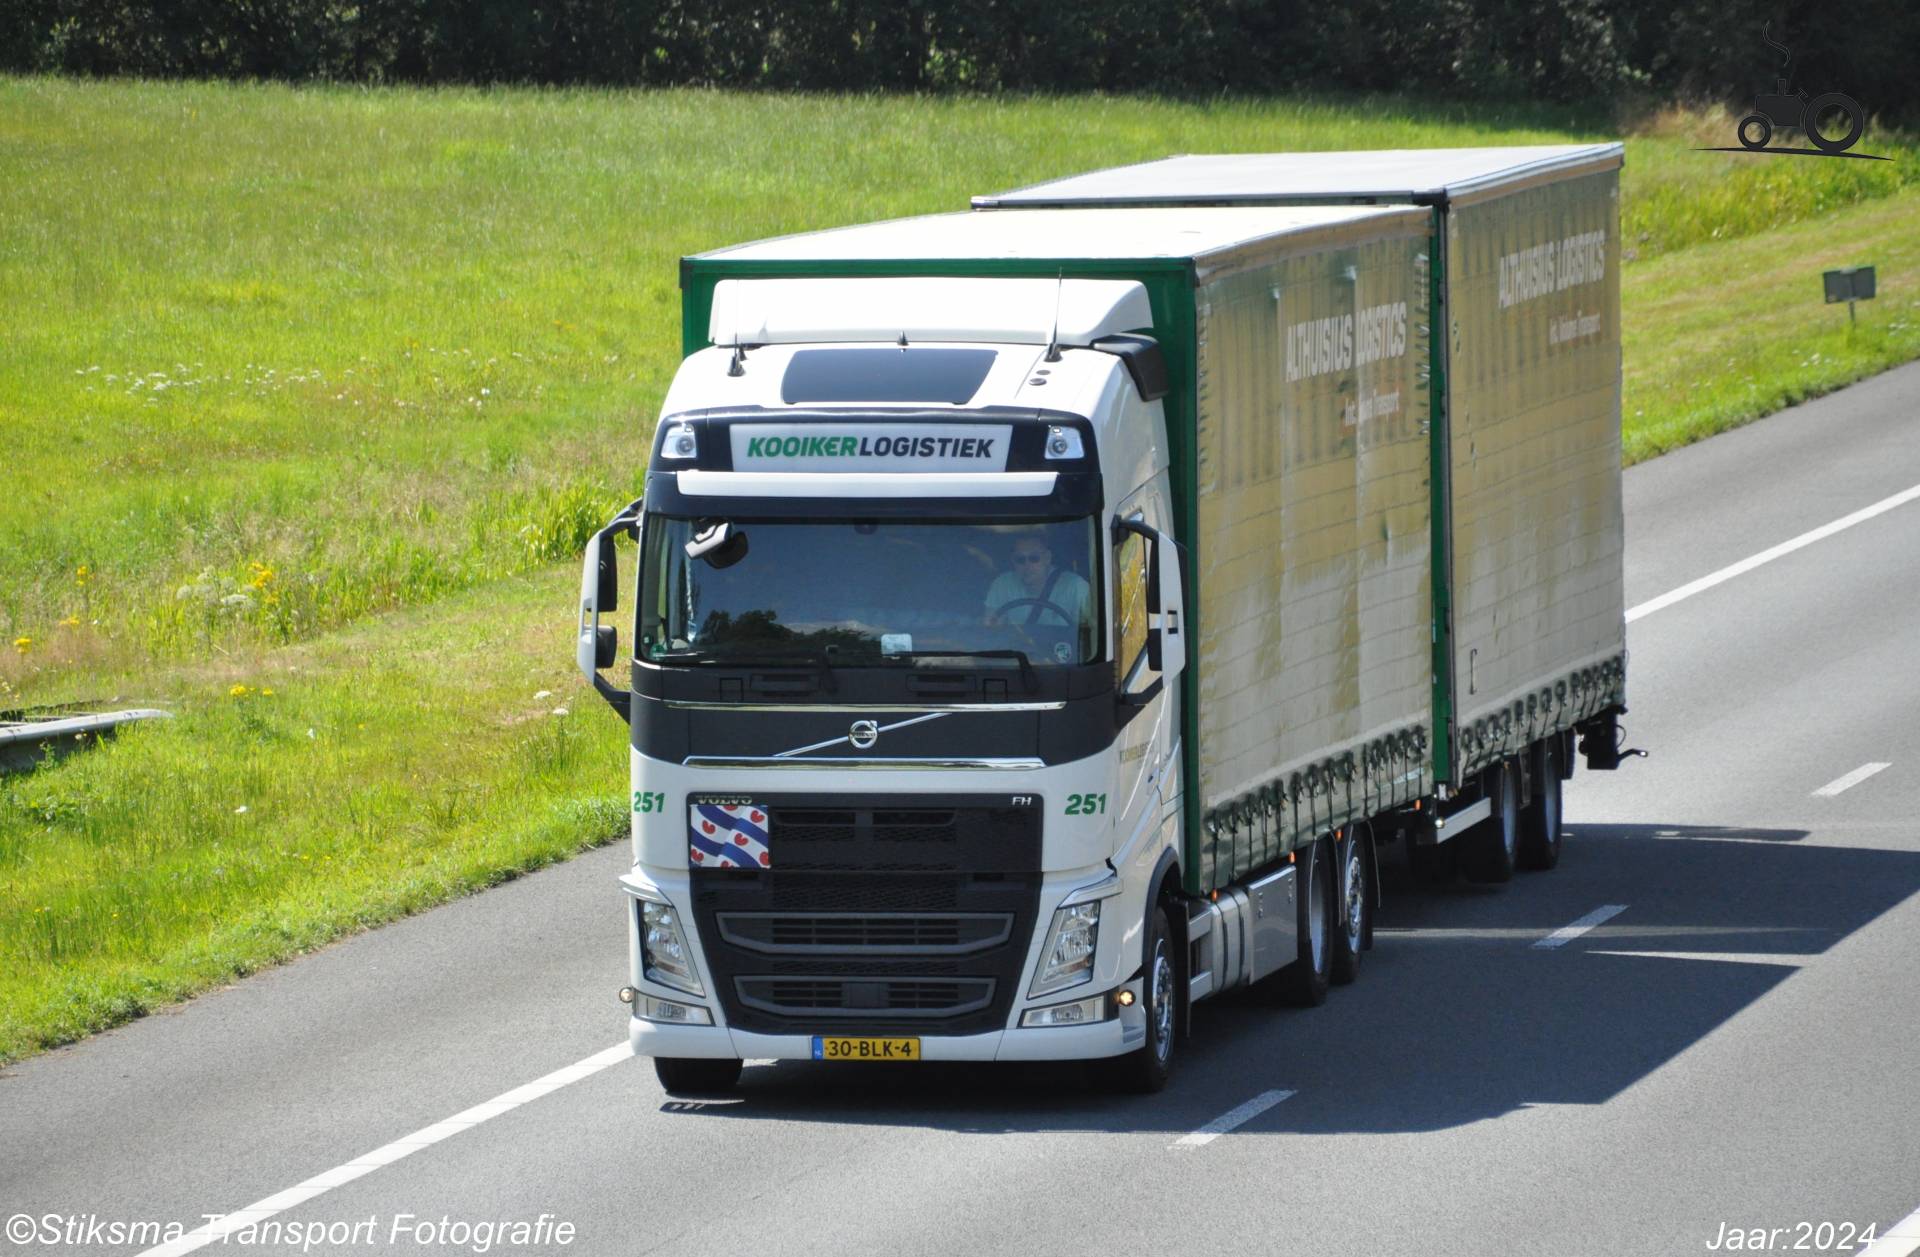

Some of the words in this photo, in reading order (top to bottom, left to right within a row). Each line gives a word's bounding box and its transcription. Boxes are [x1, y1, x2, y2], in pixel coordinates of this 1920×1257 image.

[1286, 313, 1353, 383] ALTHUISIUS
[1355, 301, 1407, 368] LOGISTICS
[633, 791, 665, 813] 251
[696, 795, 753, 805] VOLVO
[1012, 796, 1032, 806] FH
[1064, 793, 1107, 815] 251
[828, 1041, 911, 1057] 30-BLK-4
